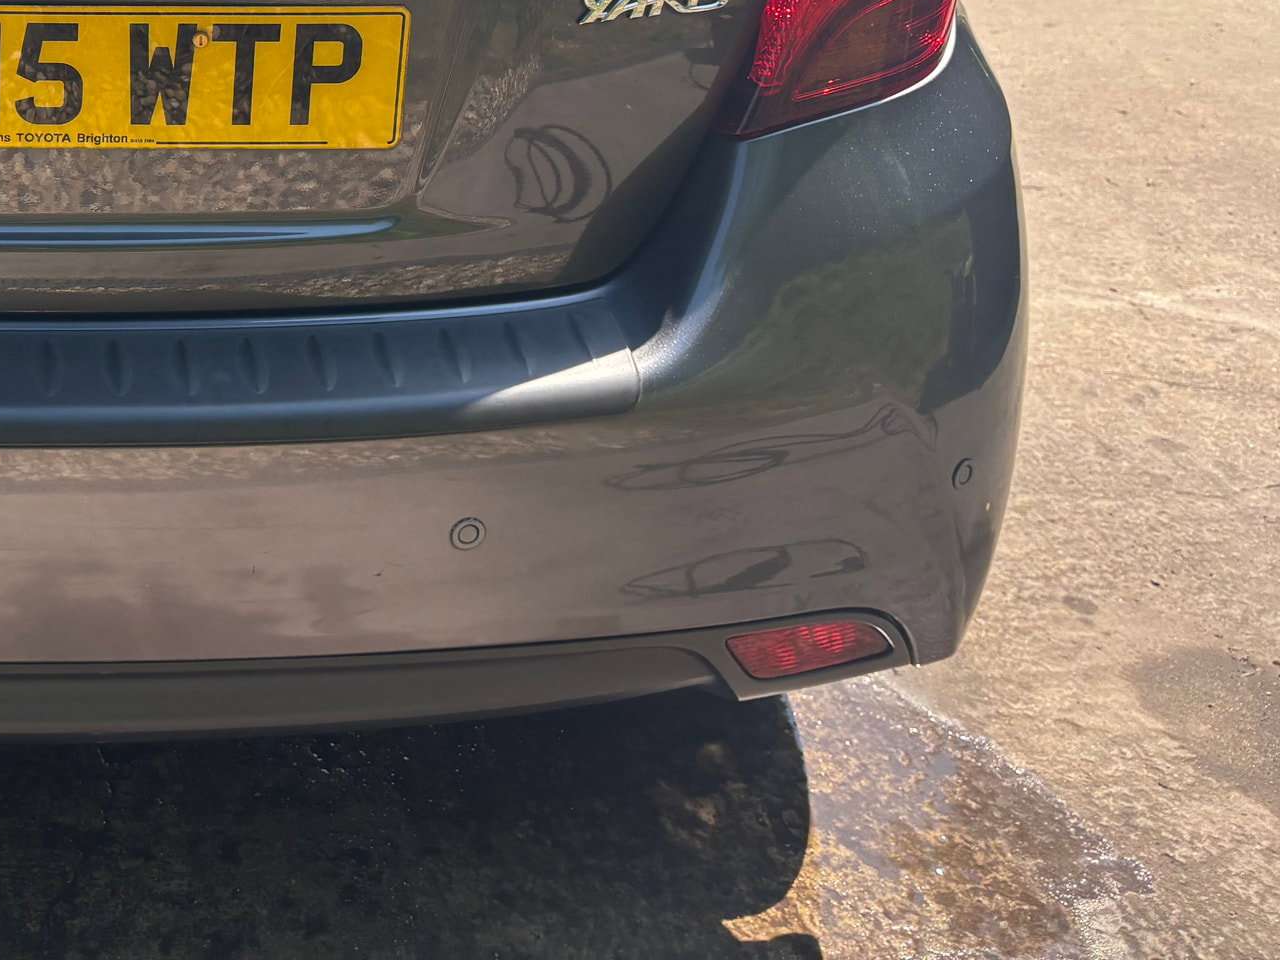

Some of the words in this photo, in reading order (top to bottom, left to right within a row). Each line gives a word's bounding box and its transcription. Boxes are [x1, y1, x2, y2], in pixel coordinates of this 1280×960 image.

[129, 23, 363, 126] WTP
[16, 132, 71, 144] TOYOTA
[76, 133, 129, 146] Brighton
